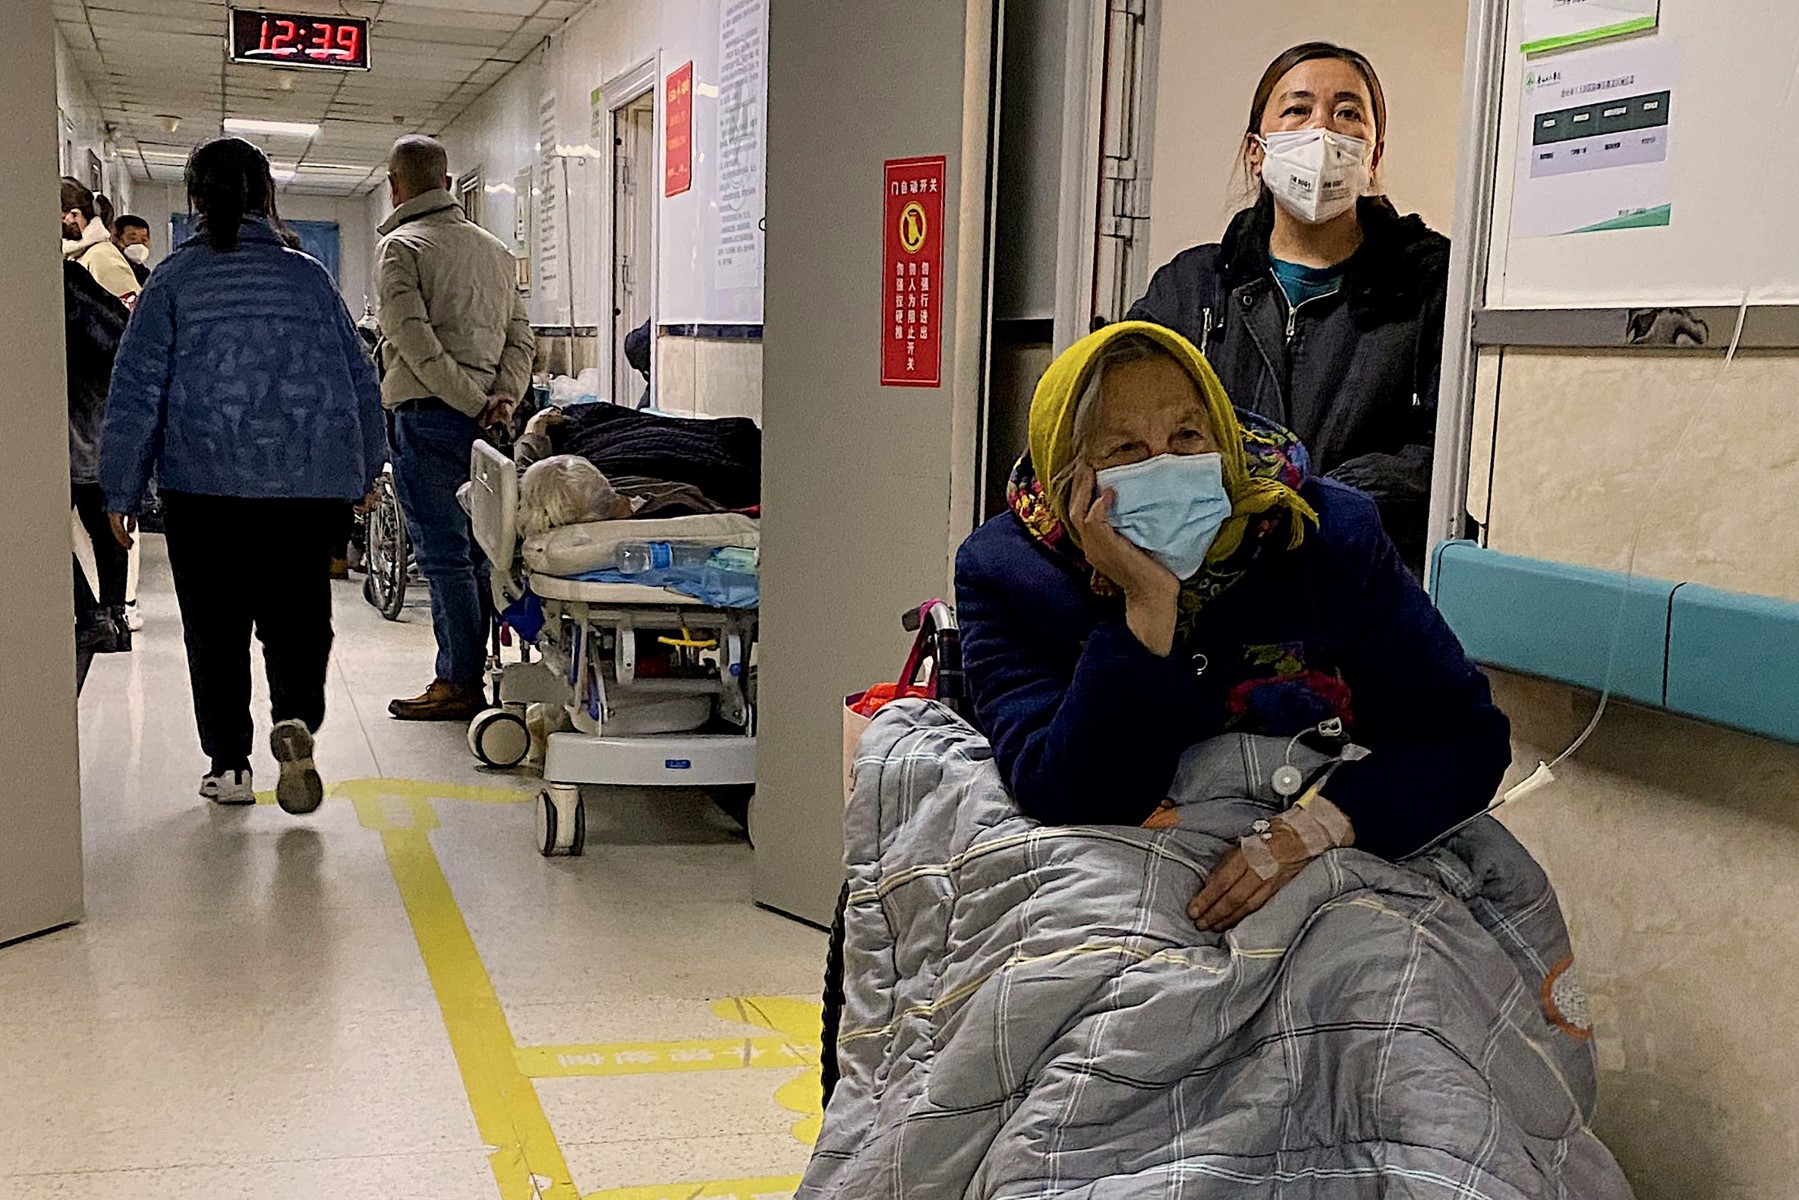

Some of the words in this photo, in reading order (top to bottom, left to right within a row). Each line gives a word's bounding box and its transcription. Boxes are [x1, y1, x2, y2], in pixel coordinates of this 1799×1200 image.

[260, 20, 358, 60] 12:39
[891, 178, 938, 195] 门自动开关
